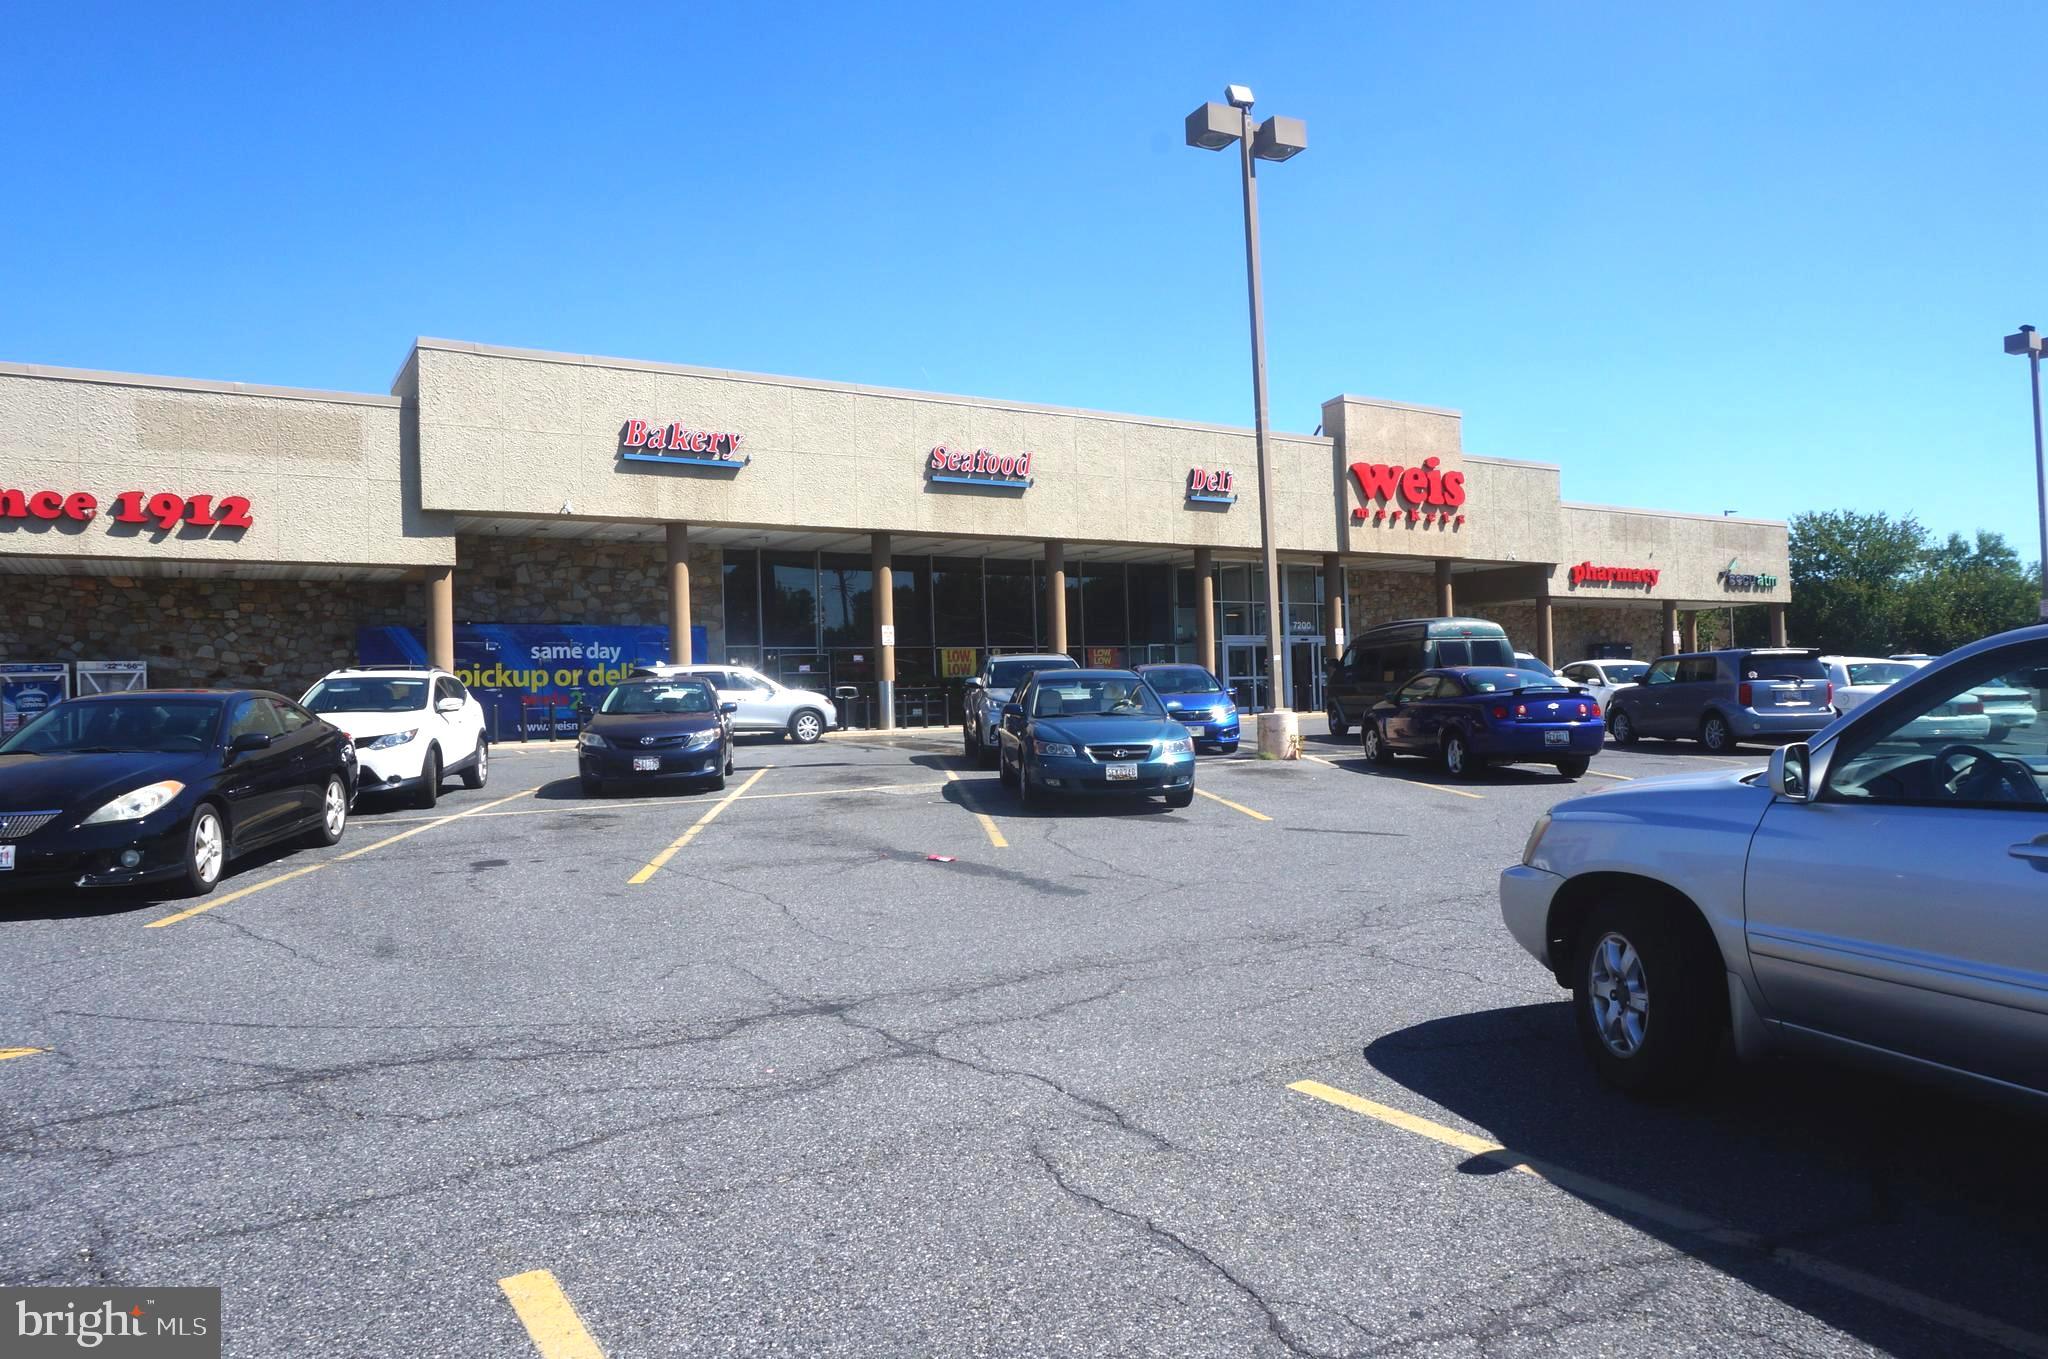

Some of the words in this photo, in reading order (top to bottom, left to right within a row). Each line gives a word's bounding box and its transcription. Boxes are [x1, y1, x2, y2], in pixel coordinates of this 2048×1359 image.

[624, 419, 744, 460] Bakery
[931, 445, 1032, 476] Seafood
[1191, 467, 1233, 492] Deli
[1350, 456, 1466, 507] weis
[115, 491, 253, 529] 1912
[1354, 507, 1466, 525] markets
[1571, 561, 1660, 587] pharmacy
[1293, 621, 1312, 630] 7200
[531, 646, 582, 659] same
[586, 641, 621, 663] day
[454, 663, 549, 693] pickup
[554, 669, 583, 687] or
